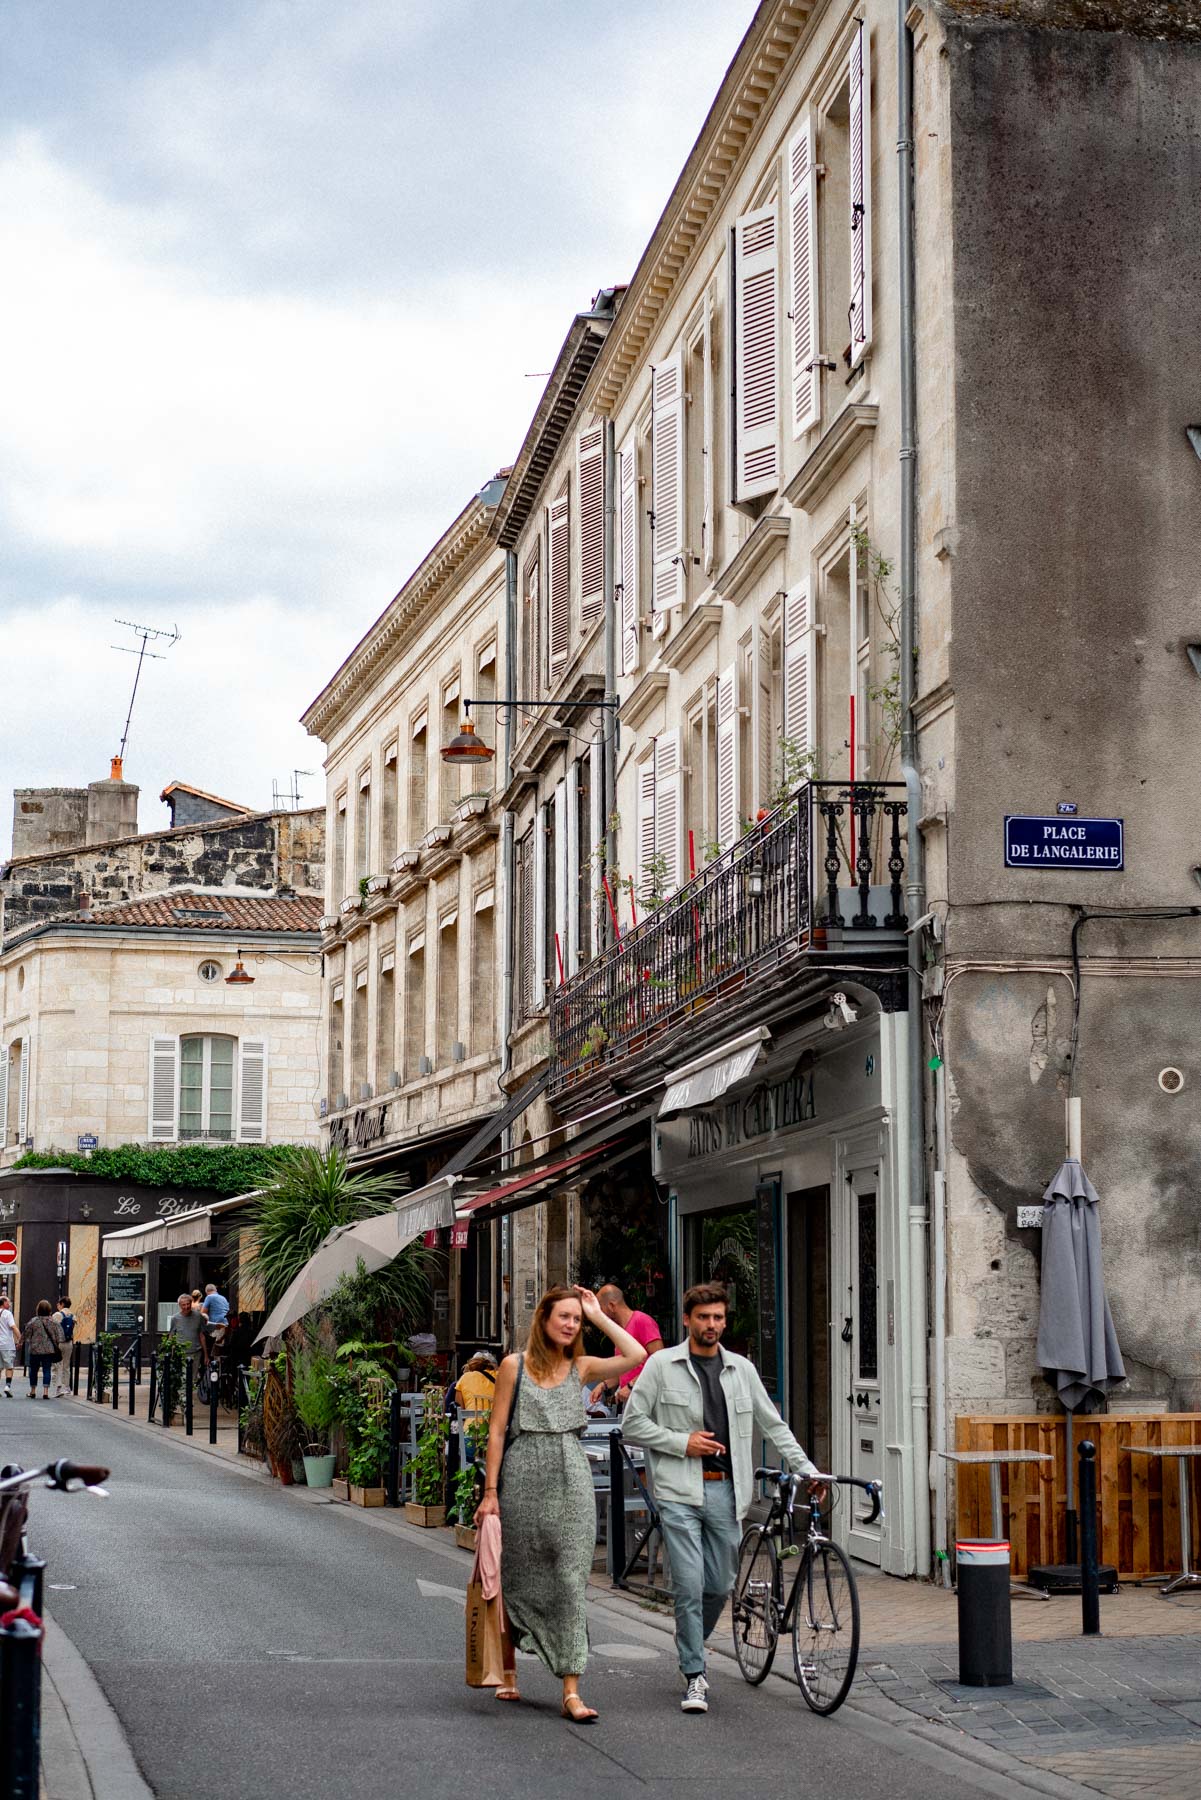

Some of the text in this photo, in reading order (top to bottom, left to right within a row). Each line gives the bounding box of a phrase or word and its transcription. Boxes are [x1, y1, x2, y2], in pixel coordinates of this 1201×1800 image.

[1043, 826, 1087, 840] PLACE
[1011, 844, 1119, 859] DE LANGALERIE
[113, 1196, 204, 1216] Le Bist
